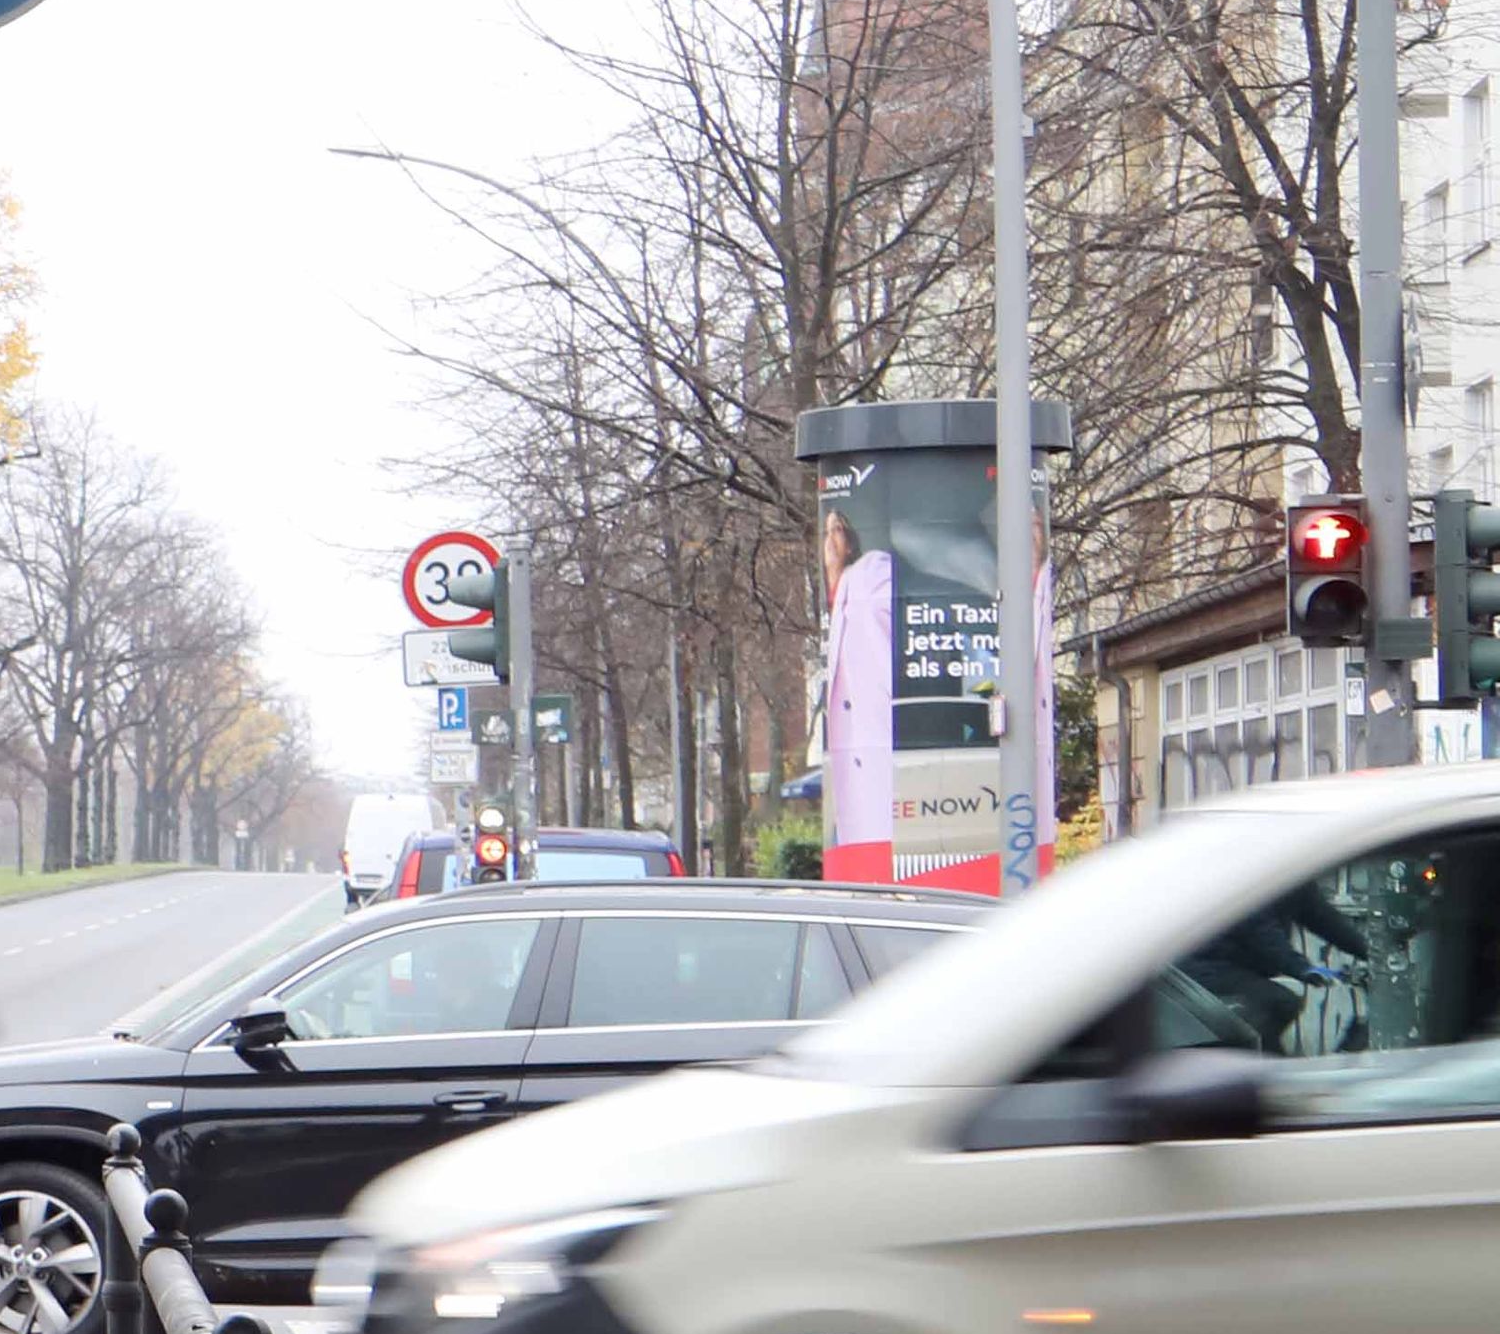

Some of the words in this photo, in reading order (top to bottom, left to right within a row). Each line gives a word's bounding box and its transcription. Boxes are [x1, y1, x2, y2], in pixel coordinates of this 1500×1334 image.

[906, 603, 945, 625] Ein
[950, 602, 998, 624] Taxi
[905, 630, 963, 656] jetzt
[905, 657, 940, 678] als
[947, 658, 984, 677] ein
[922, 797, 981, 816] NOW
